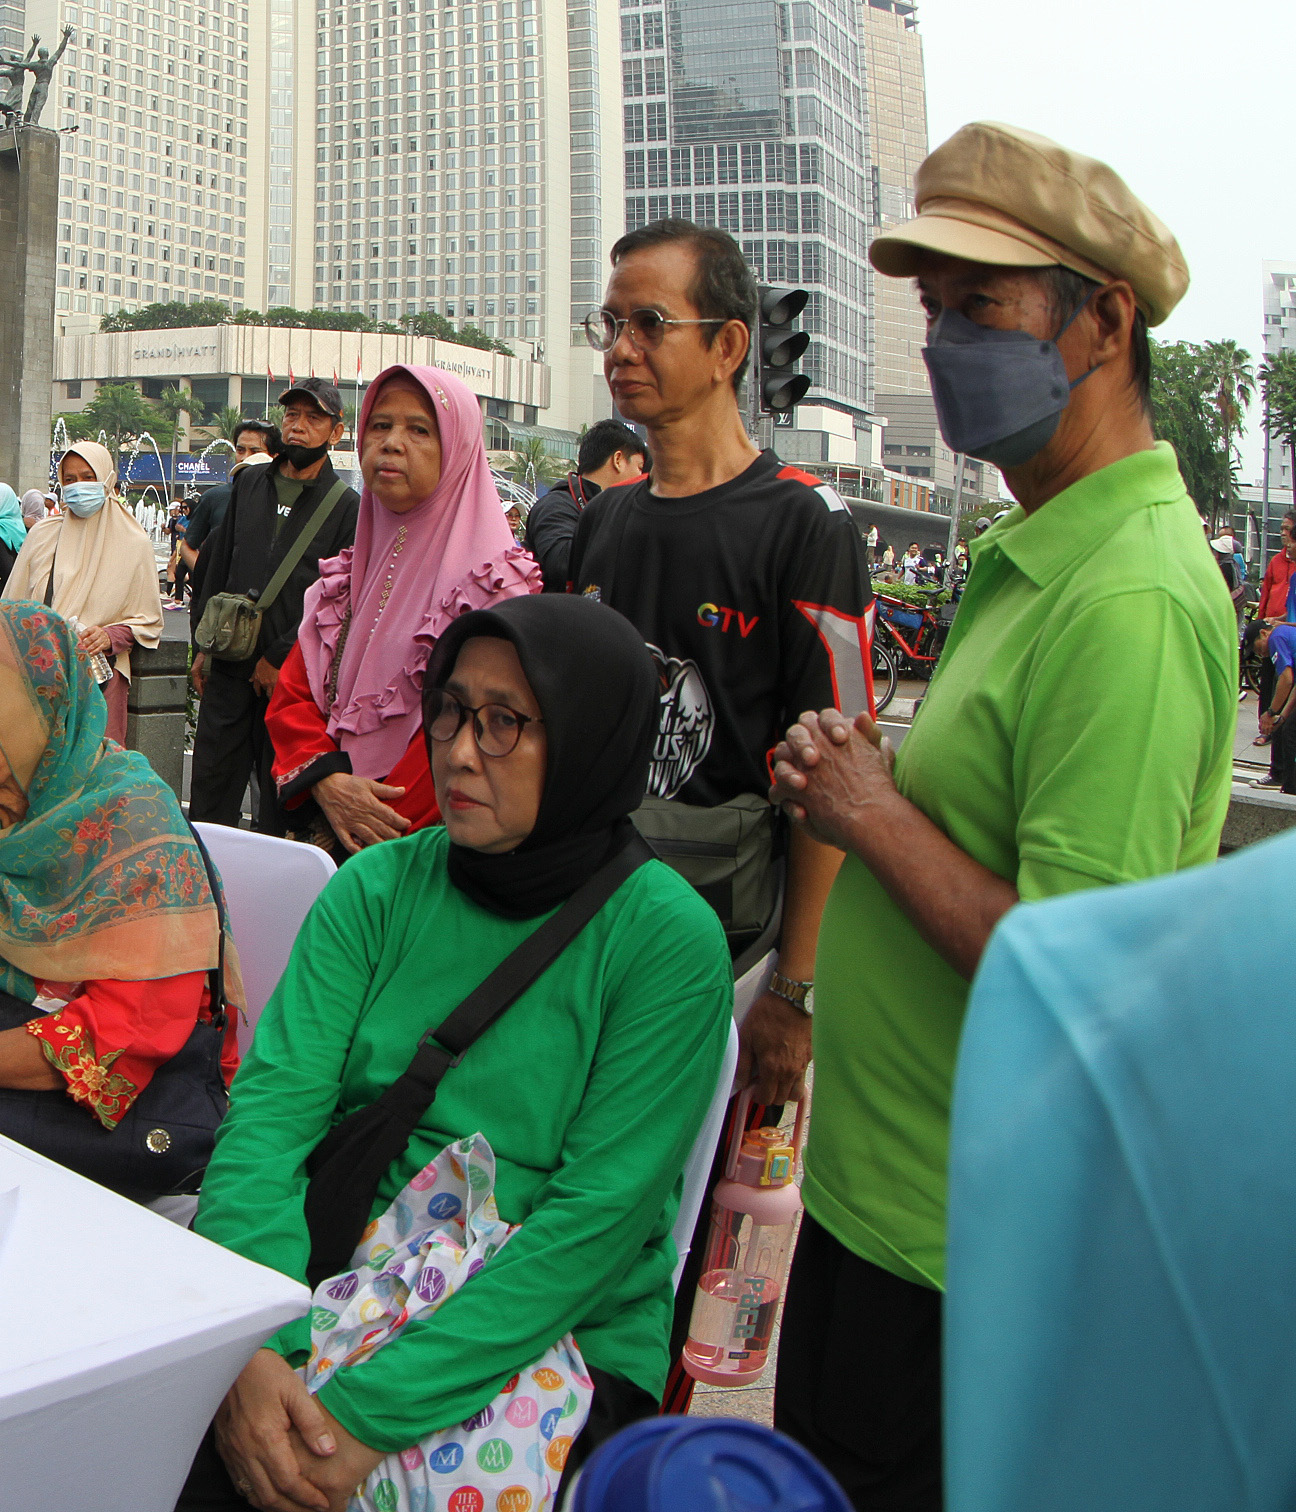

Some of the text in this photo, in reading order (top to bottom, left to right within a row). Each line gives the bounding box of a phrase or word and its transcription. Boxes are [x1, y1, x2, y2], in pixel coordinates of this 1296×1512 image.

[134, 345, 217, 359] GRAND HYATT
[434, 359, 492, 380] GRAND HYATT
[177, 462, 210, 471] CHANEL
[697, 602, 760, 638] GTV
